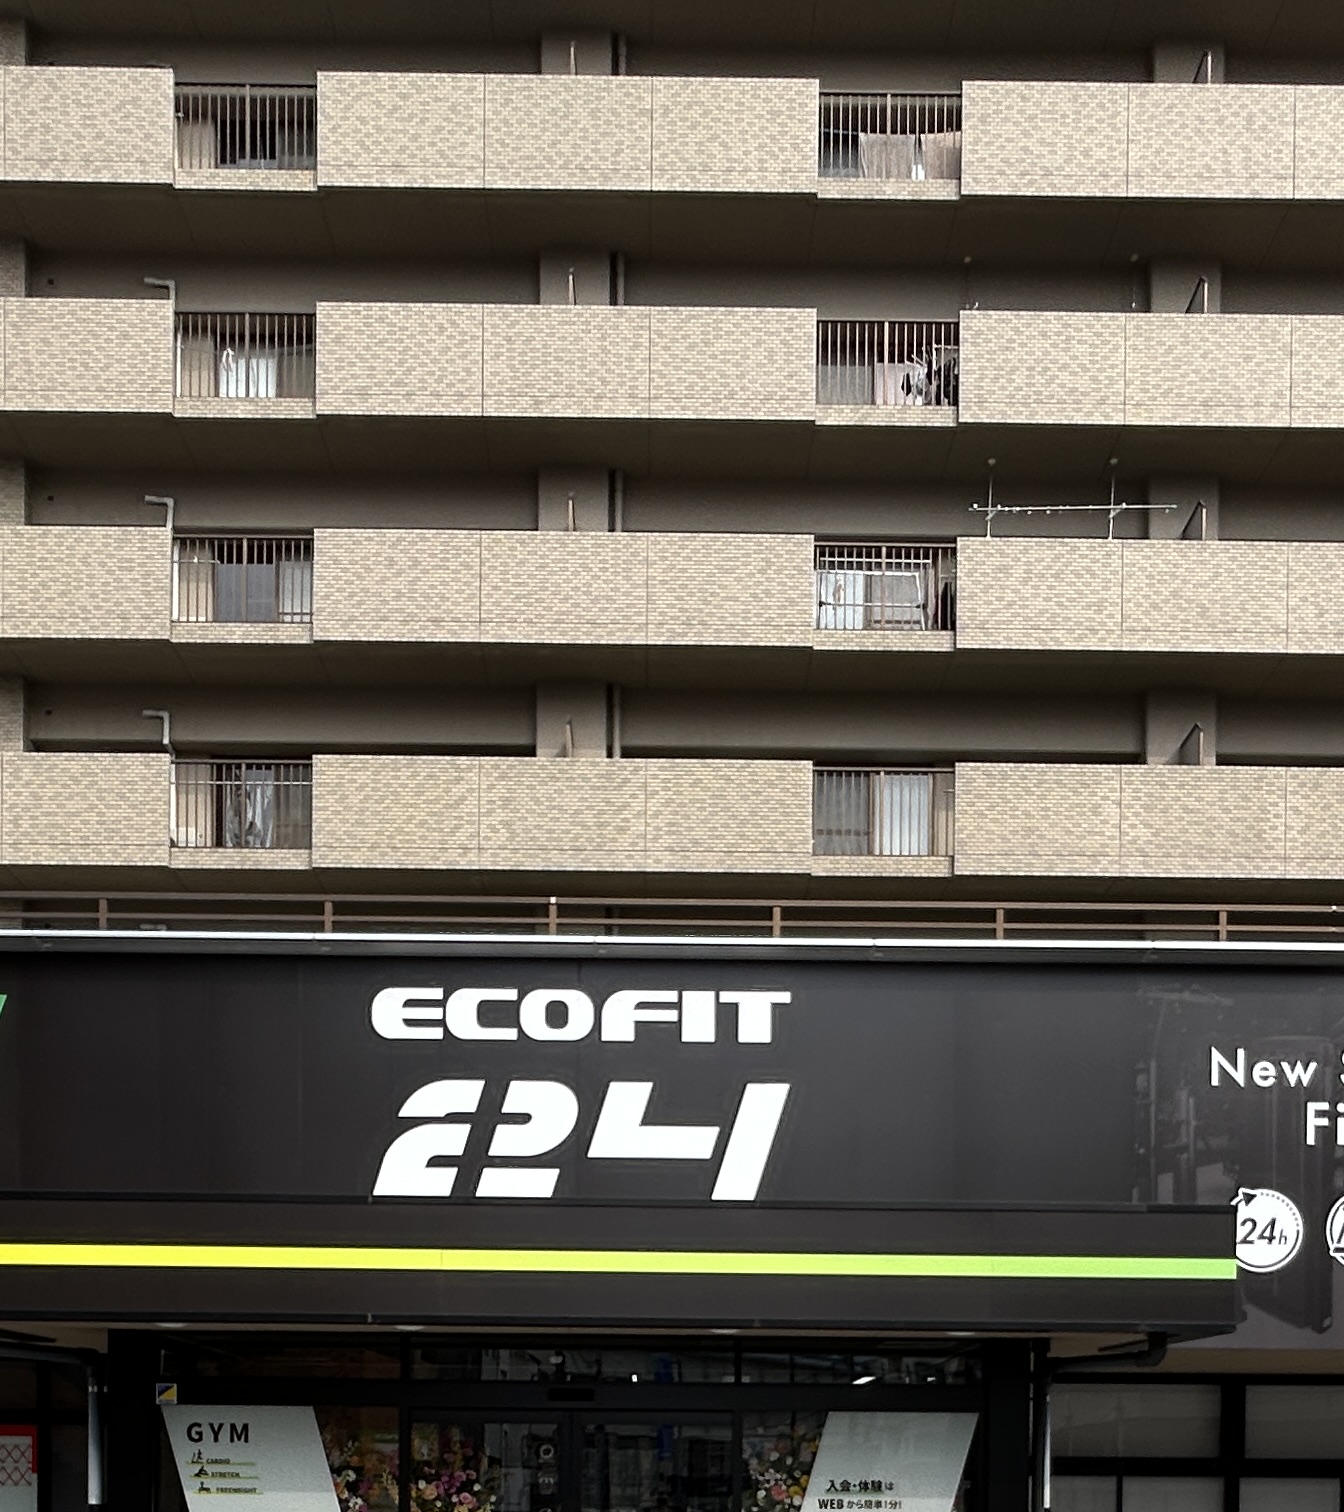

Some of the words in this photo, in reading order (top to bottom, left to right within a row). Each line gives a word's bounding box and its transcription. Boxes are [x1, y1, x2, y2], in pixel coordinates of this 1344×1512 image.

[371, 987, 792, 1043] ECOFIT
[1210, 1048, 1318, 1088] New
[372, 1079, 791, 1201] 24
[186, 1422, 249, 1443] GYM
